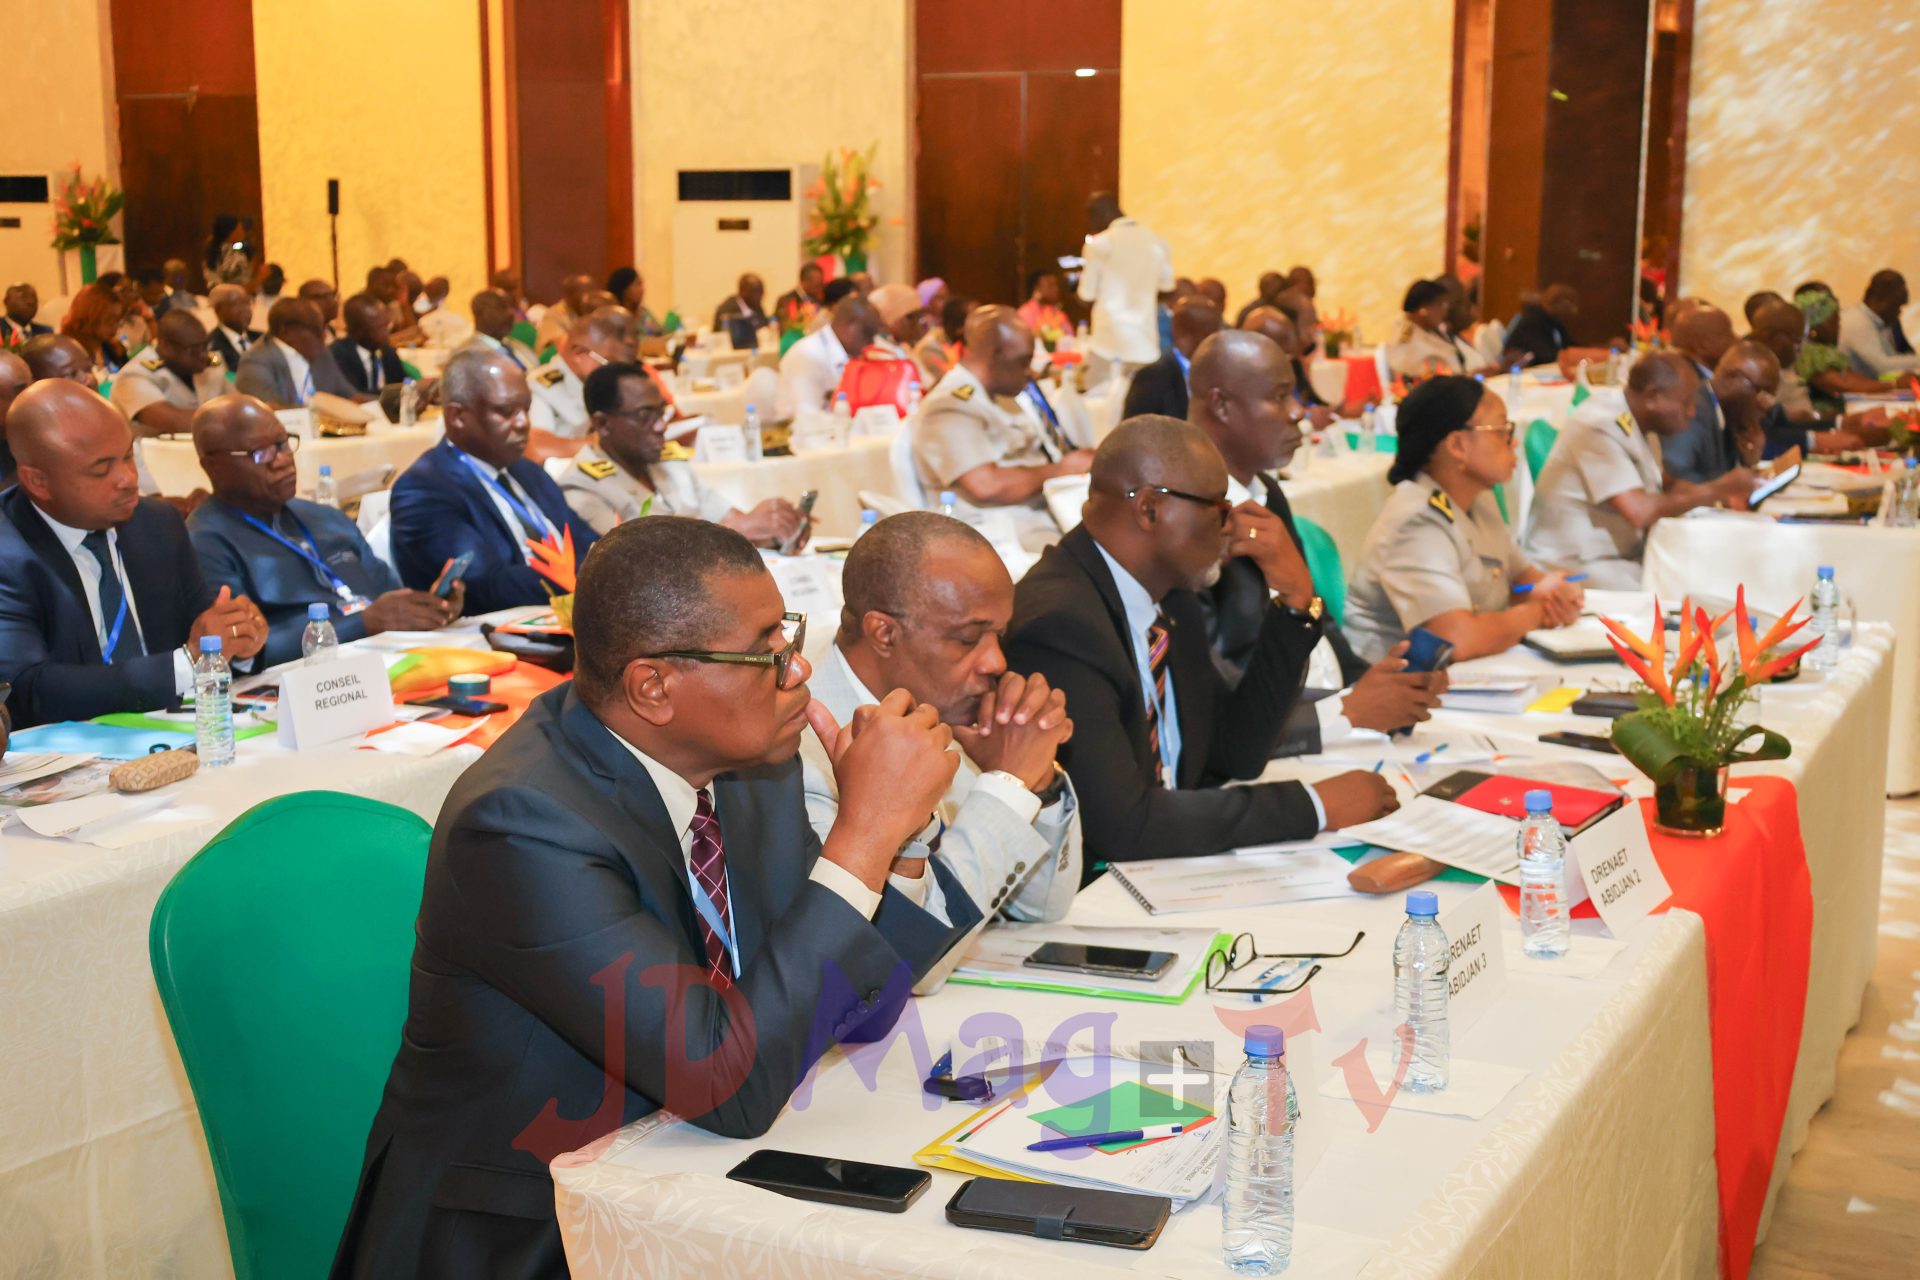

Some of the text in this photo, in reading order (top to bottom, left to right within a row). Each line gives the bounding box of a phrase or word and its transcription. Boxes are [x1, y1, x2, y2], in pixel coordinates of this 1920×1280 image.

[314, 689, 368, 710] REGIONAL
[316, 673, 360, 693] CONSEIL
[1590, 848, 1629, 884] DRENAET
[1601, 868, 1642, 907] ABIDJAN 2
[1448, 923, 1481, 963] RENAET
[1448, 952, 1488, 1000] ABIDJAN 3
